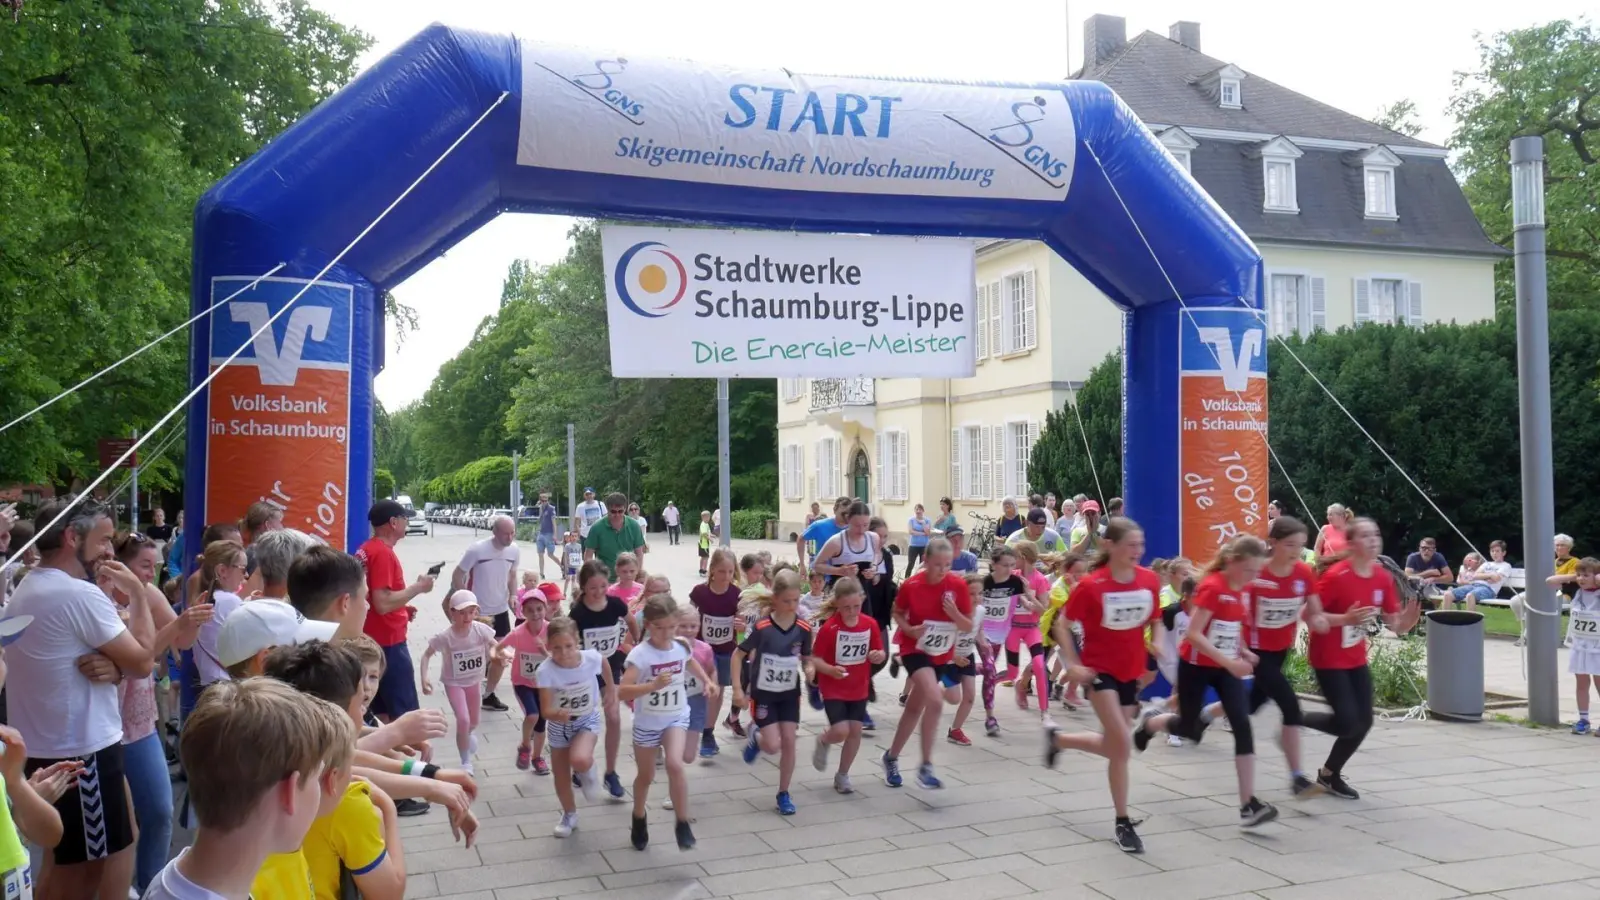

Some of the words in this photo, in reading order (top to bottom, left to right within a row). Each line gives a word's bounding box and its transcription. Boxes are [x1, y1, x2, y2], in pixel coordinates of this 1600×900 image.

[724, 84, 902, 139] START
[615, 137, 806, 173] Skigemeinschaft
[810, 156, 995, 187] Nordschaumburg
[693, 253, 861, 285] Stadtwerke
[694, 290, 964, 328] Schaumburg-Lippe
[692, 340, 737, 364] Die
[231, 395, 327, 414] Volksbank
[1201, 398, 1262, 412] Volksbank
[211, 418, 225, 434] in
[230, 418, 346, 443] Schaumburg
[1183, 417, 1197, 430] in
[1184, 473, 1214, 510] die
[984, 606, 1006, 616] 300
[706, 626, 730, 638] 309
[1574, 619, 1597, 632] 272
[591, 637, 616, 651] 337
[924, 634, 949, 647] 281
[841, 644, 867, 657] 278
[459, 656, 482, 671] 308
[766, 669, 792, 683] 342
[560, 693, 589, 708] 269
[649, 690, 678, 706] 311
